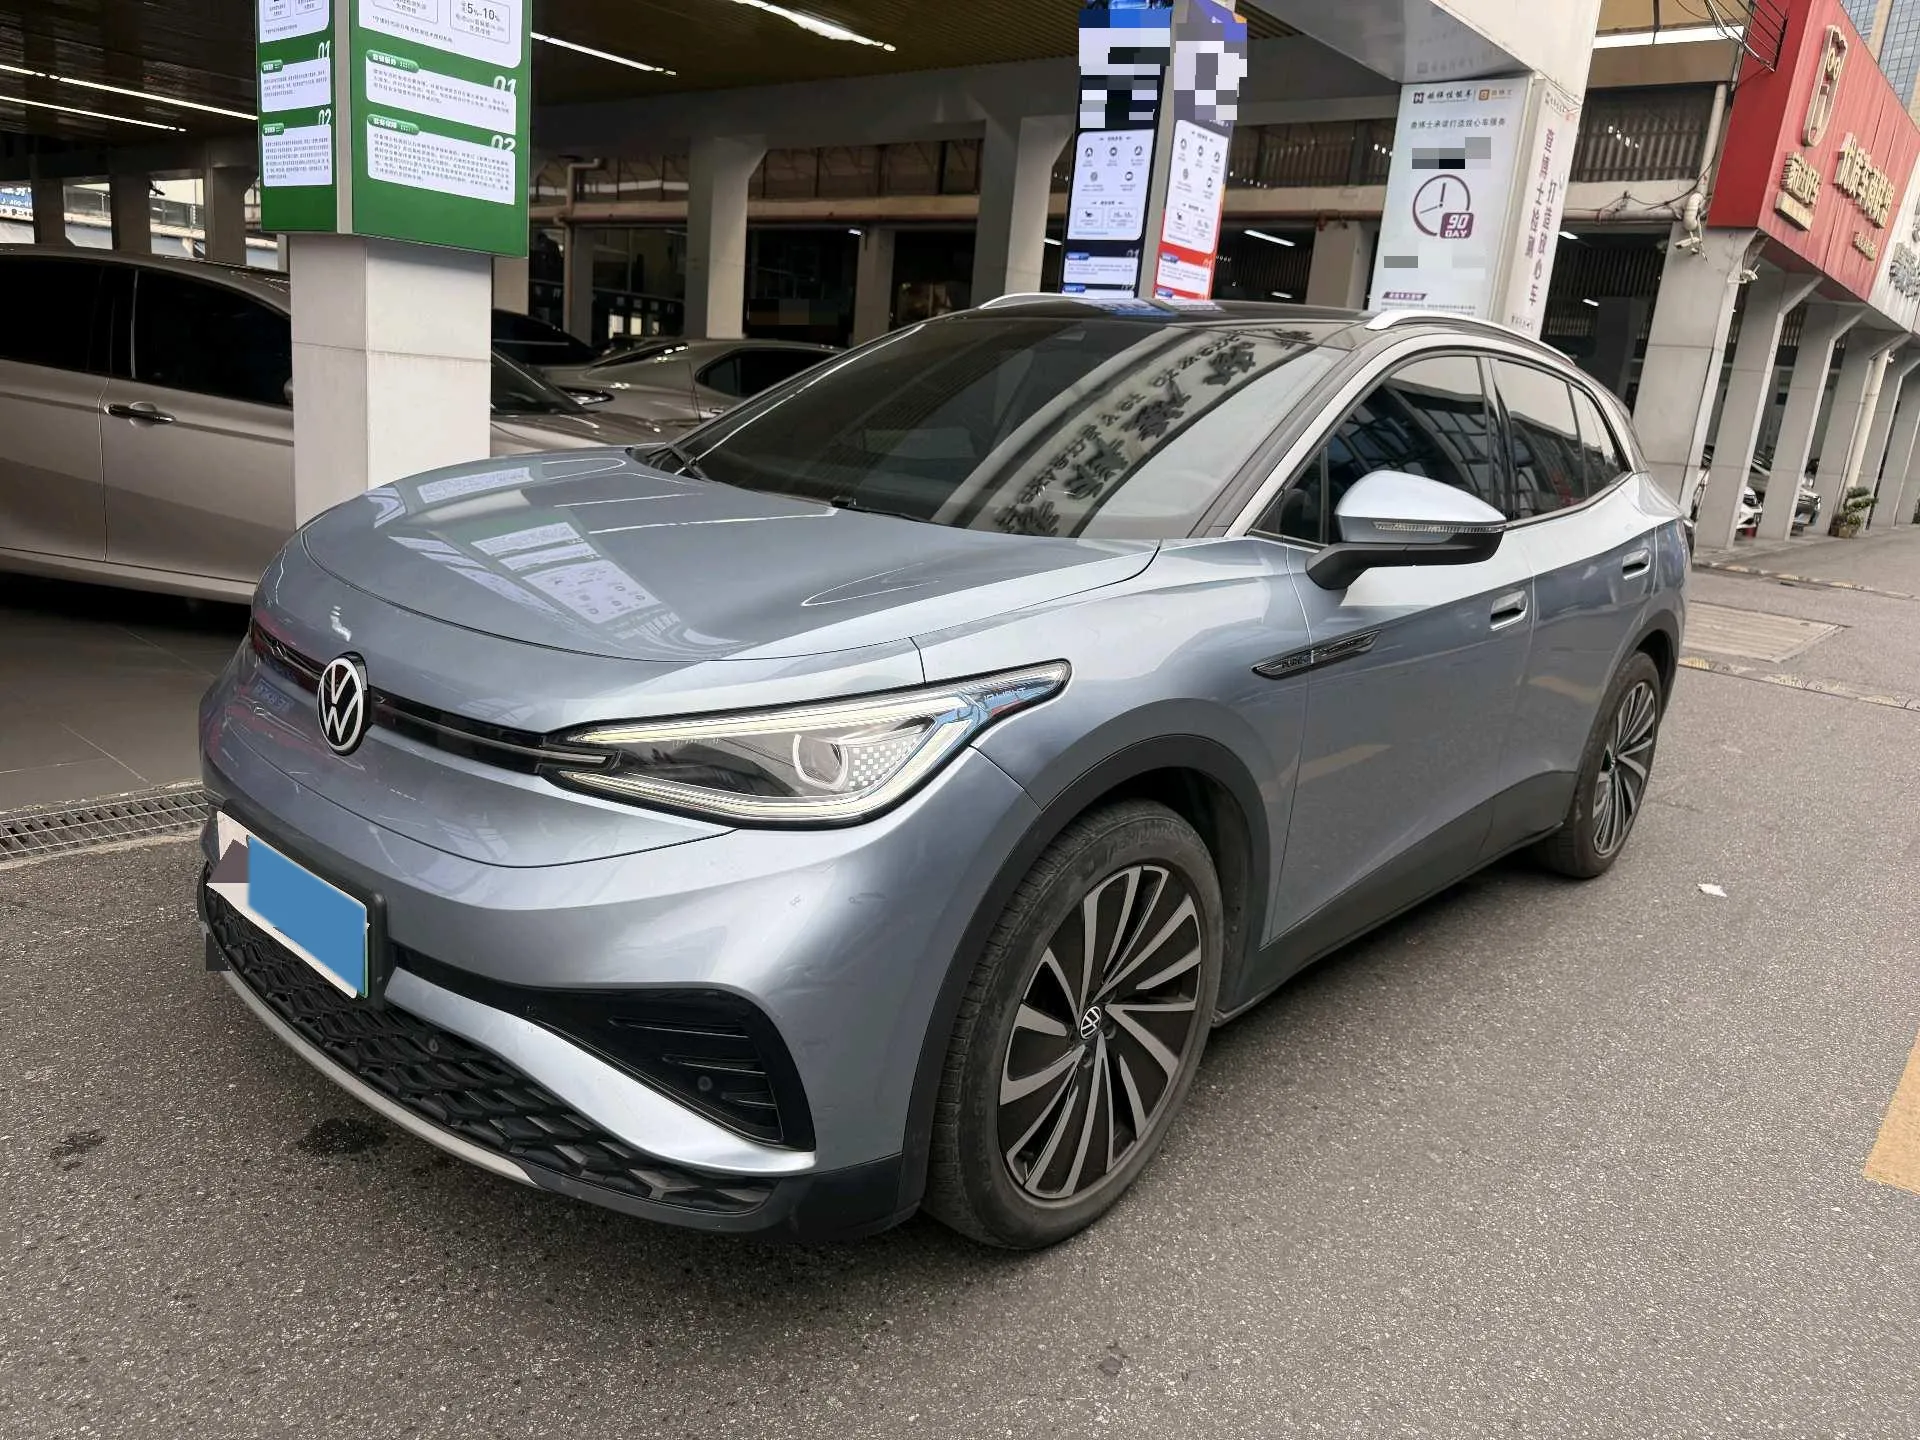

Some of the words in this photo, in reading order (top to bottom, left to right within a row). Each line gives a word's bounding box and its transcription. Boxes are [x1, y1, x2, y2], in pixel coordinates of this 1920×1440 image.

[318, 40, 331, 59] 01
[494, 75, 516, 93] 01
[318, 108, 332, 126] 02
[490, 134, 516, 151] 02
[1447, 214, 1470, 229] 90
[1444, 230, 1468, 238] DAY
